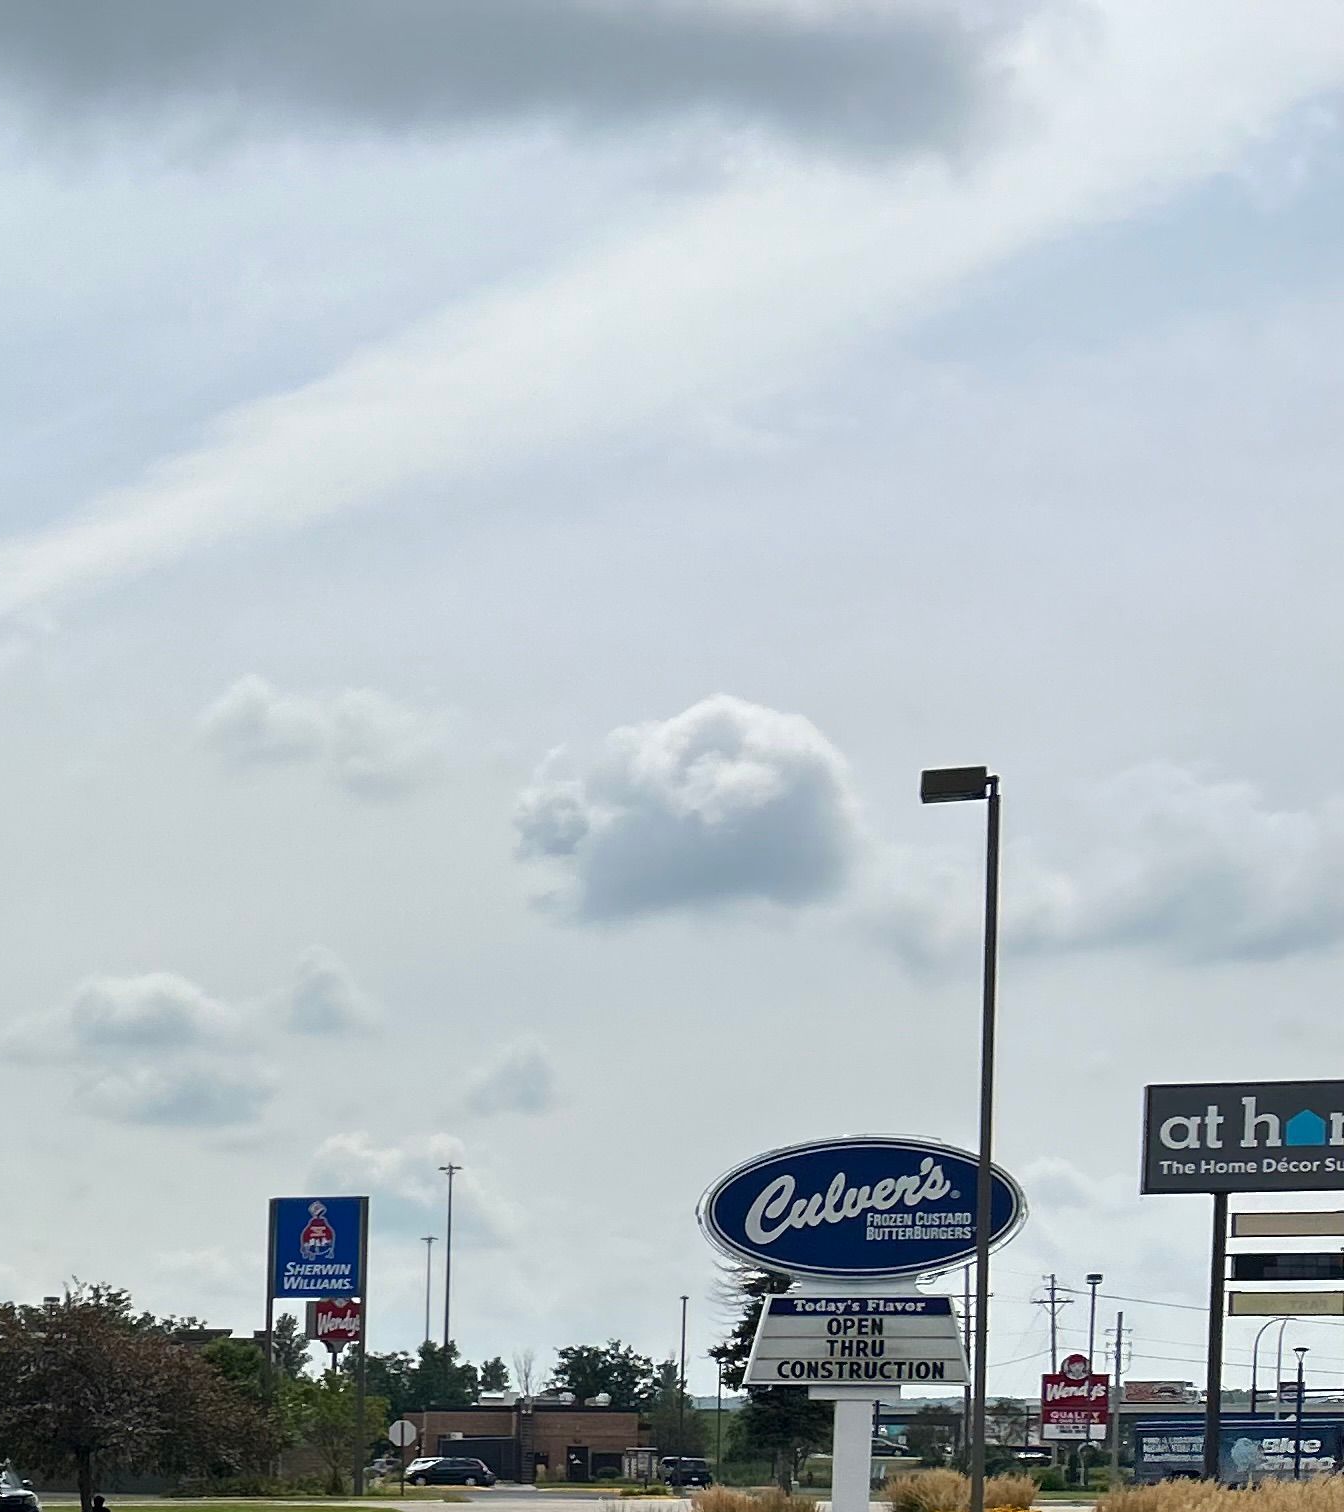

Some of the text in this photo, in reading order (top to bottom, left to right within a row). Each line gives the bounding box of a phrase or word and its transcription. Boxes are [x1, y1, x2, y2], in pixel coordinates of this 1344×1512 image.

[1159, 1105, 1224, 1150] at
[1160, 1161, 1196, 1175] The
[1200, 1160, 1257, 1174] Home
[1263, 1157, 1321, 1173] Décor
[744, 1156, 952, 1245] Culver's
[866, 1212, 972, 1226] FROZEN CUSTARD
[284, 1262, 351, 1276] SHERWIN
[283, 1277, 352, 1290] WILLIAMS
[794, 1299, 926, 1314] Today's Flavor
[826, 1317, 884, 1336] OPEN
[826, 1339, 885, 1357] THRU
[777, 1360, 945, 1379] CONSTRUCTION
